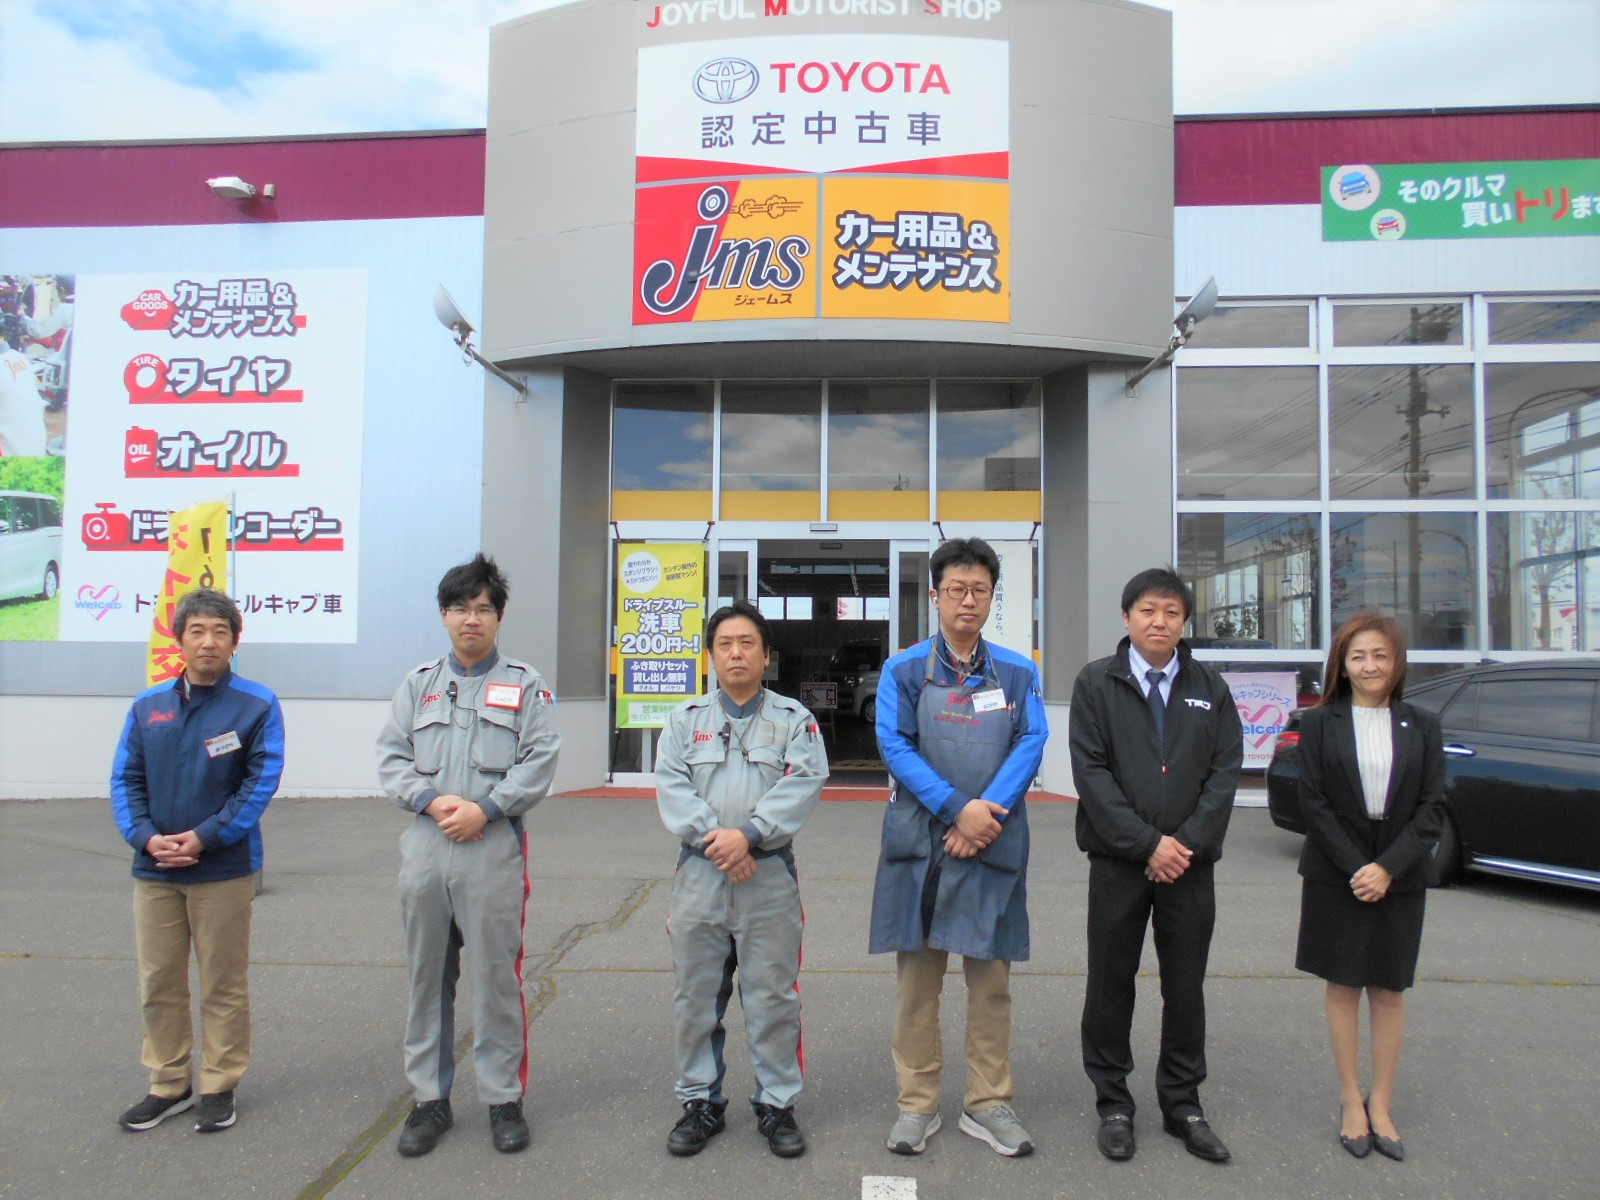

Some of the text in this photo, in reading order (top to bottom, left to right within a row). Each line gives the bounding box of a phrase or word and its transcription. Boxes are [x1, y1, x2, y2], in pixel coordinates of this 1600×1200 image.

[646, 0, 1002, 28] JOYFUL MOTORIST SHOP
[770, 62, 951, 95] TOYOTA
[701, 111, 941, 148] 認定中古車
[1398, 174, 1506, 203] そのクルマ
[834, 253, 999, 292] メンテナンス
[133, 301, 168, 310] GOODS
[140, 293, 162, 302] CAR
[734, 292, 793, 306] ジェームス
[170, 308, 296, 337] メンテナンス
[133, 356, 159, 367] TIRE
[166, 357, 289, 396] タイヤ
[128, 444, 151, 455] OIL
[160, 432, 284, 470] オイル
[75, 600, 122, 609] Welcab
[624, 599, 697, 612] ドライブスルー
[638, 612, 681, 633] 洗車
[630, 661, 689, 671] ふき取りセット
[1185, 698, 1211, 711] TRD
